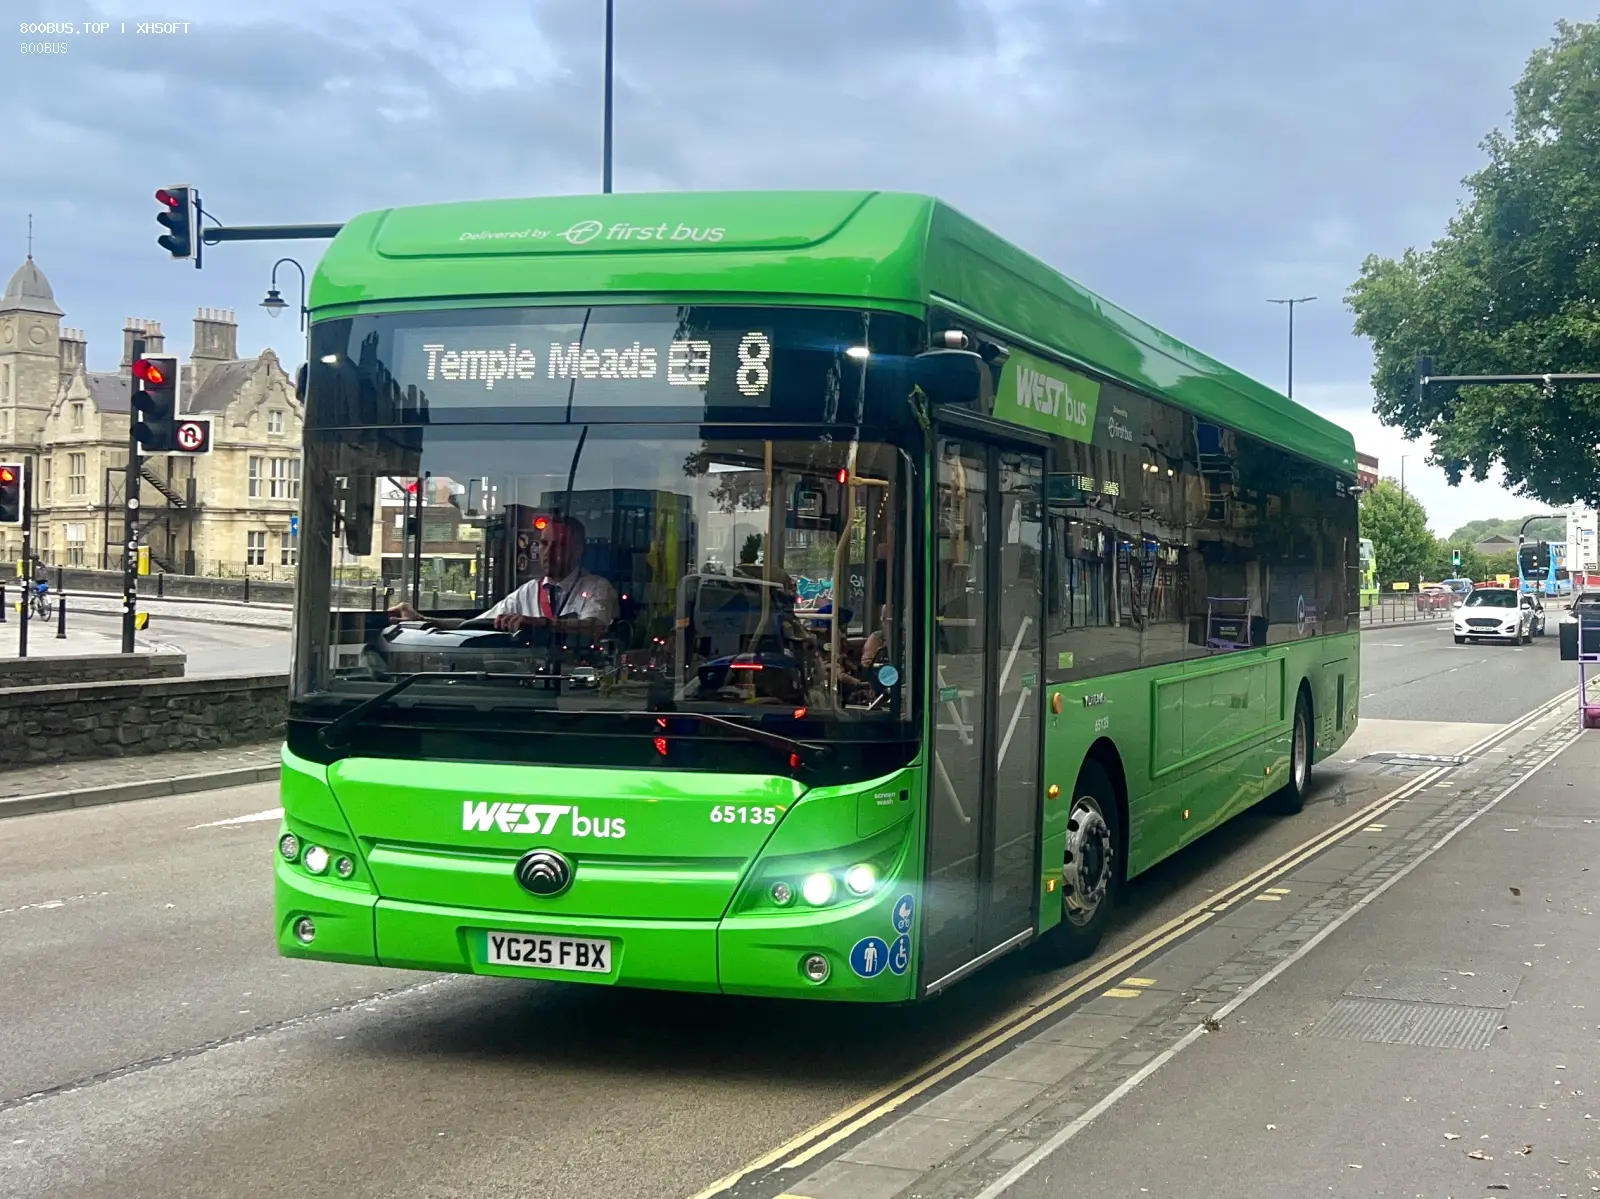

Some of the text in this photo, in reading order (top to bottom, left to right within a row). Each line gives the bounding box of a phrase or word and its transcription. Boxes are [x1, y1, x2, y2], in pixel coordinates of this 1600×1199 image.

[459, 228, 551, 241] Delivered by
[606, 223, 726, 242] first bus
[423, 341, 658, 390] Temple Meads
[737, 332, 771, 396] 8
[709, 805, 776, 825] 65135
[491, 935, 606, 968] YG25 FBX
